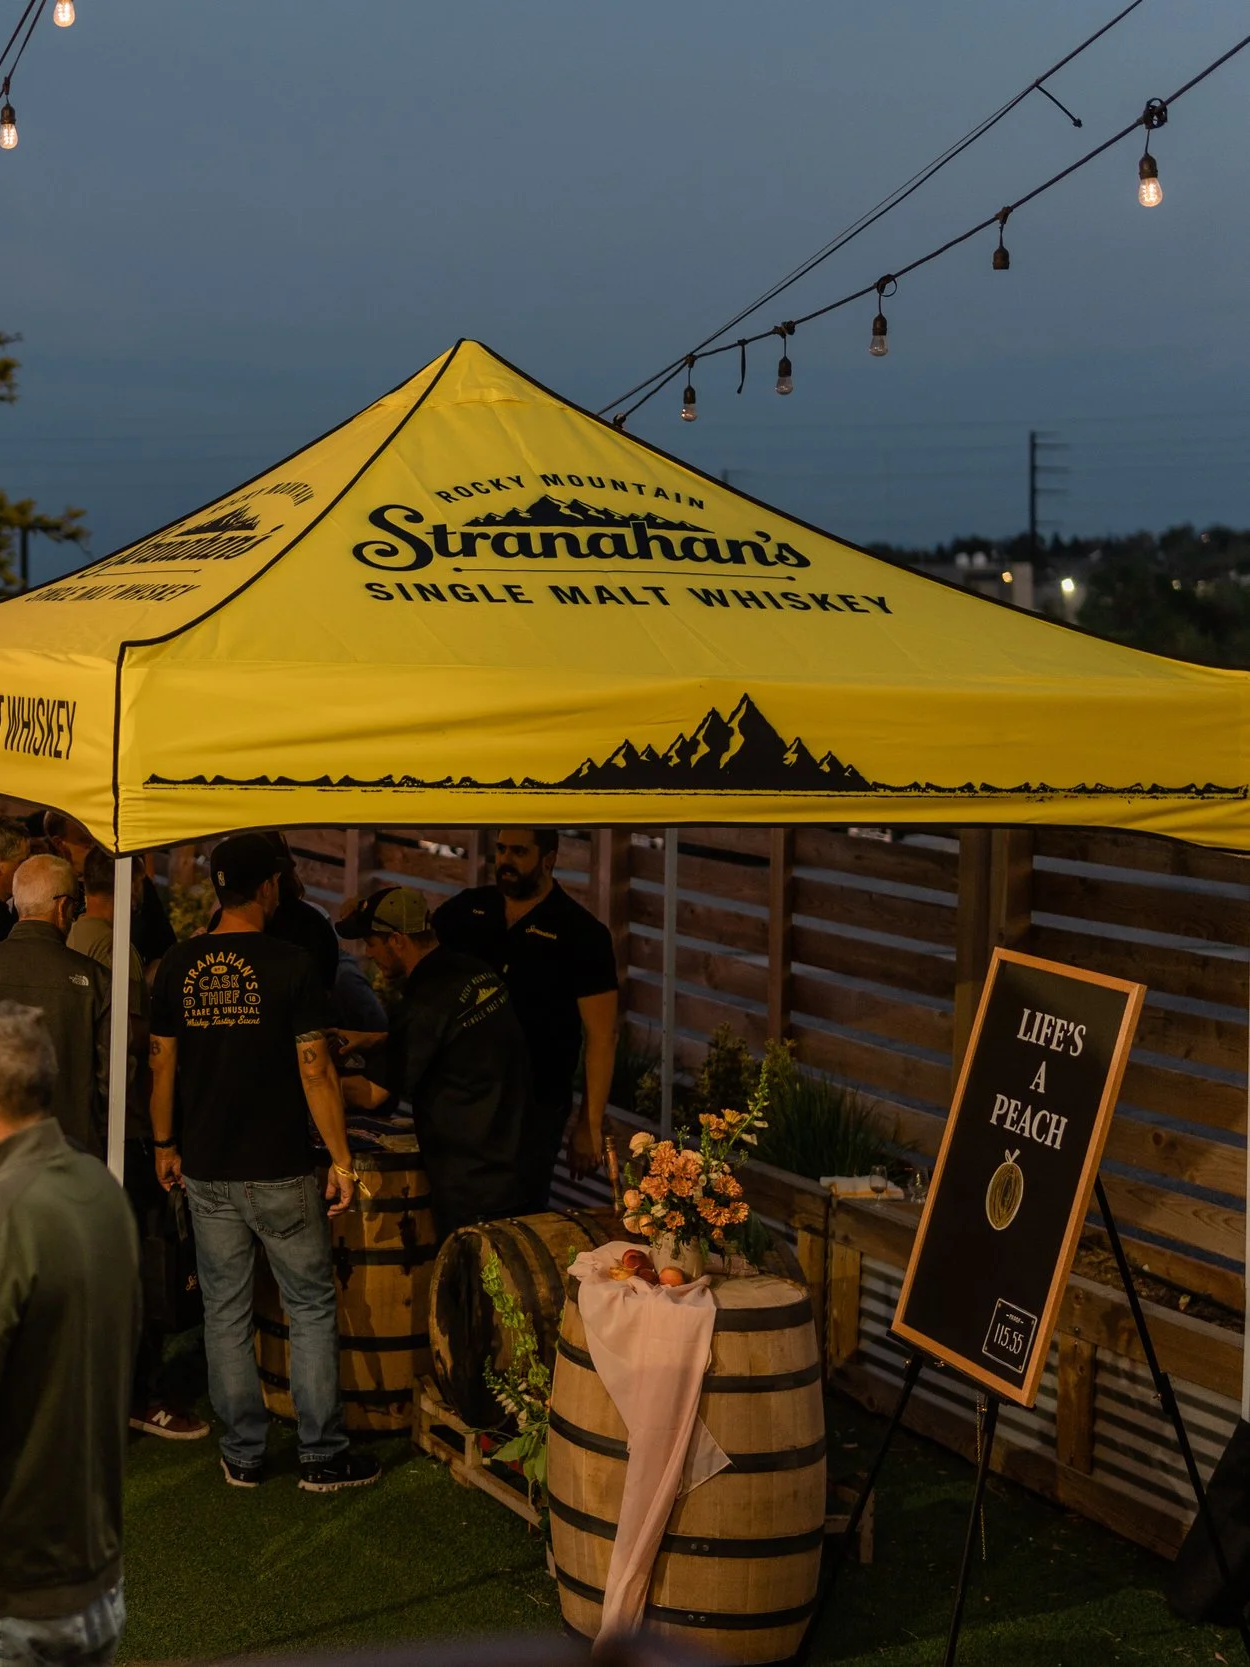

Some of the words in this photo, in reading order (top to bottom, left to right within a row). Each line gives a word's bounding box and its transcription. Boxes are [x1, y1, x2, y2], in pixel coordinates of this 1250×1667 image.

[436, 475, 524, 503] ROCKY
[540, 473, 705, 509] MOUNTAIN
[352, 504, 811, 571] Stranahan's
[365, 582, 534, 604] SINGLE
[550, 584, 672, 607] MALT
[687, 587, 894, 615] WHISKEY
[4, 696, 77, 760] WHISKEY
[183, 951, 259, 994] STRANAHAN'S
[199, 975, 239, 990] CASK
[192, 1008, 210, 1016] RARE
[213, 1007, 220, 1015] &
[222, 1006, 260, 1014] UNUSUAL
[200, 990, 240, 1006] THIEF
[212, 1016, 236, 1026] Tasting
[237, 1015, 260, 1024] Event
[1016, 1007, 1087, 1058] LIFE'S
[1029, 1060, 1047, 1094] A
[989, 1093, 1069, 1151] PEACH
[993, 1322, 1025, 1355] 115.55
